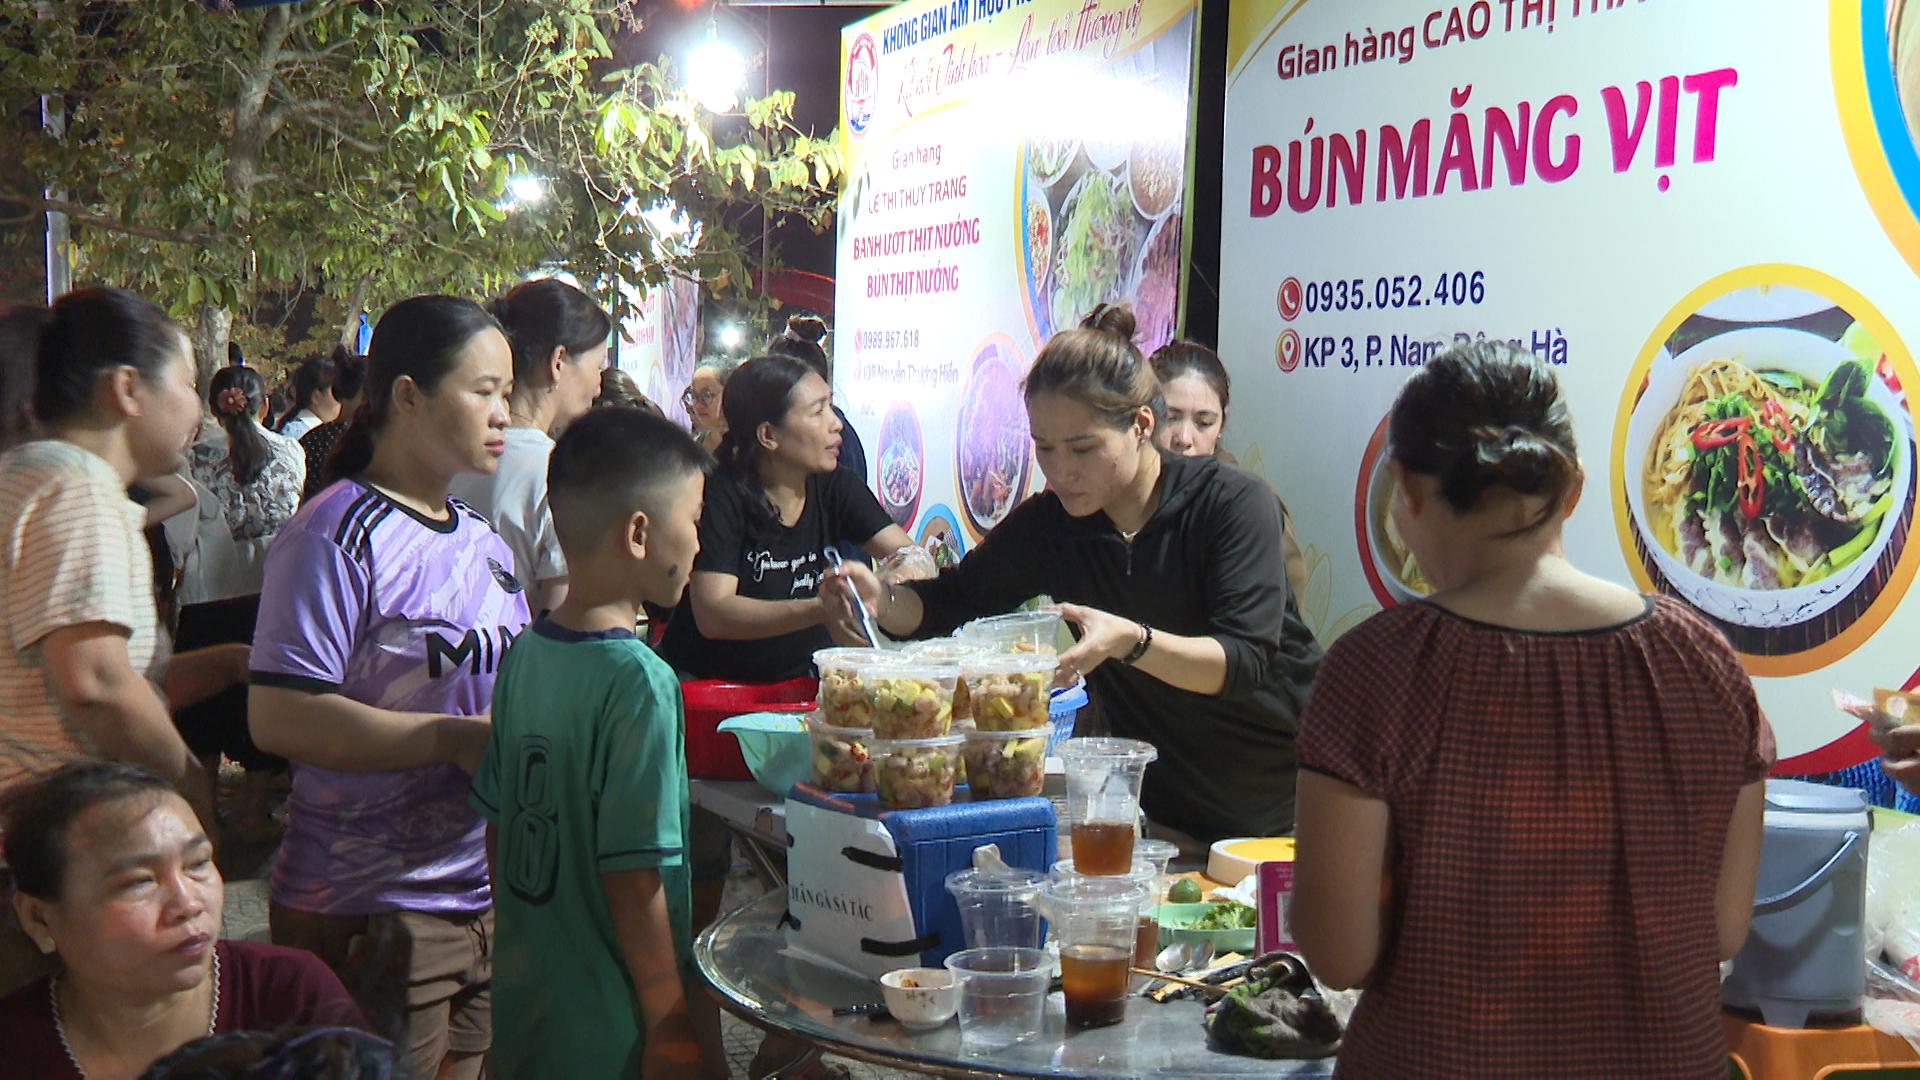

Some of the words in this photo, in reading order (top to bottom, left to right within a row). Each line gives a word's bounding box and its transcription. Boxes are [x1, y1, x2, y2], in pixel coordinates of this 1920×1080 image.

[921, 4, 947, 42] GIAN
[1277, 43, 1337, 80] Gian
[1343, 27, 1416, 68] hàng
[1422, 0, 1491, 49] CAO
[1249, 117, 1368, 218] BÚN
[1374, 84, 1581, 202] MĂNG
[1600, 67, 1738, 192] VỊT
[928, 175, 967, 204] TRANG
[935, 213, 980, 249] NƯỚNG
[916, 259, 959, 294] NƯỚNG
[1305, 270, 1485, 313] 0935.052.406
[1304, 335, 1335, 368] KP
[1340, 336, 1360, 373] 3,
[1365, 334, 1383, 366] P.
[1531, 327, 1568, 366] Hà
